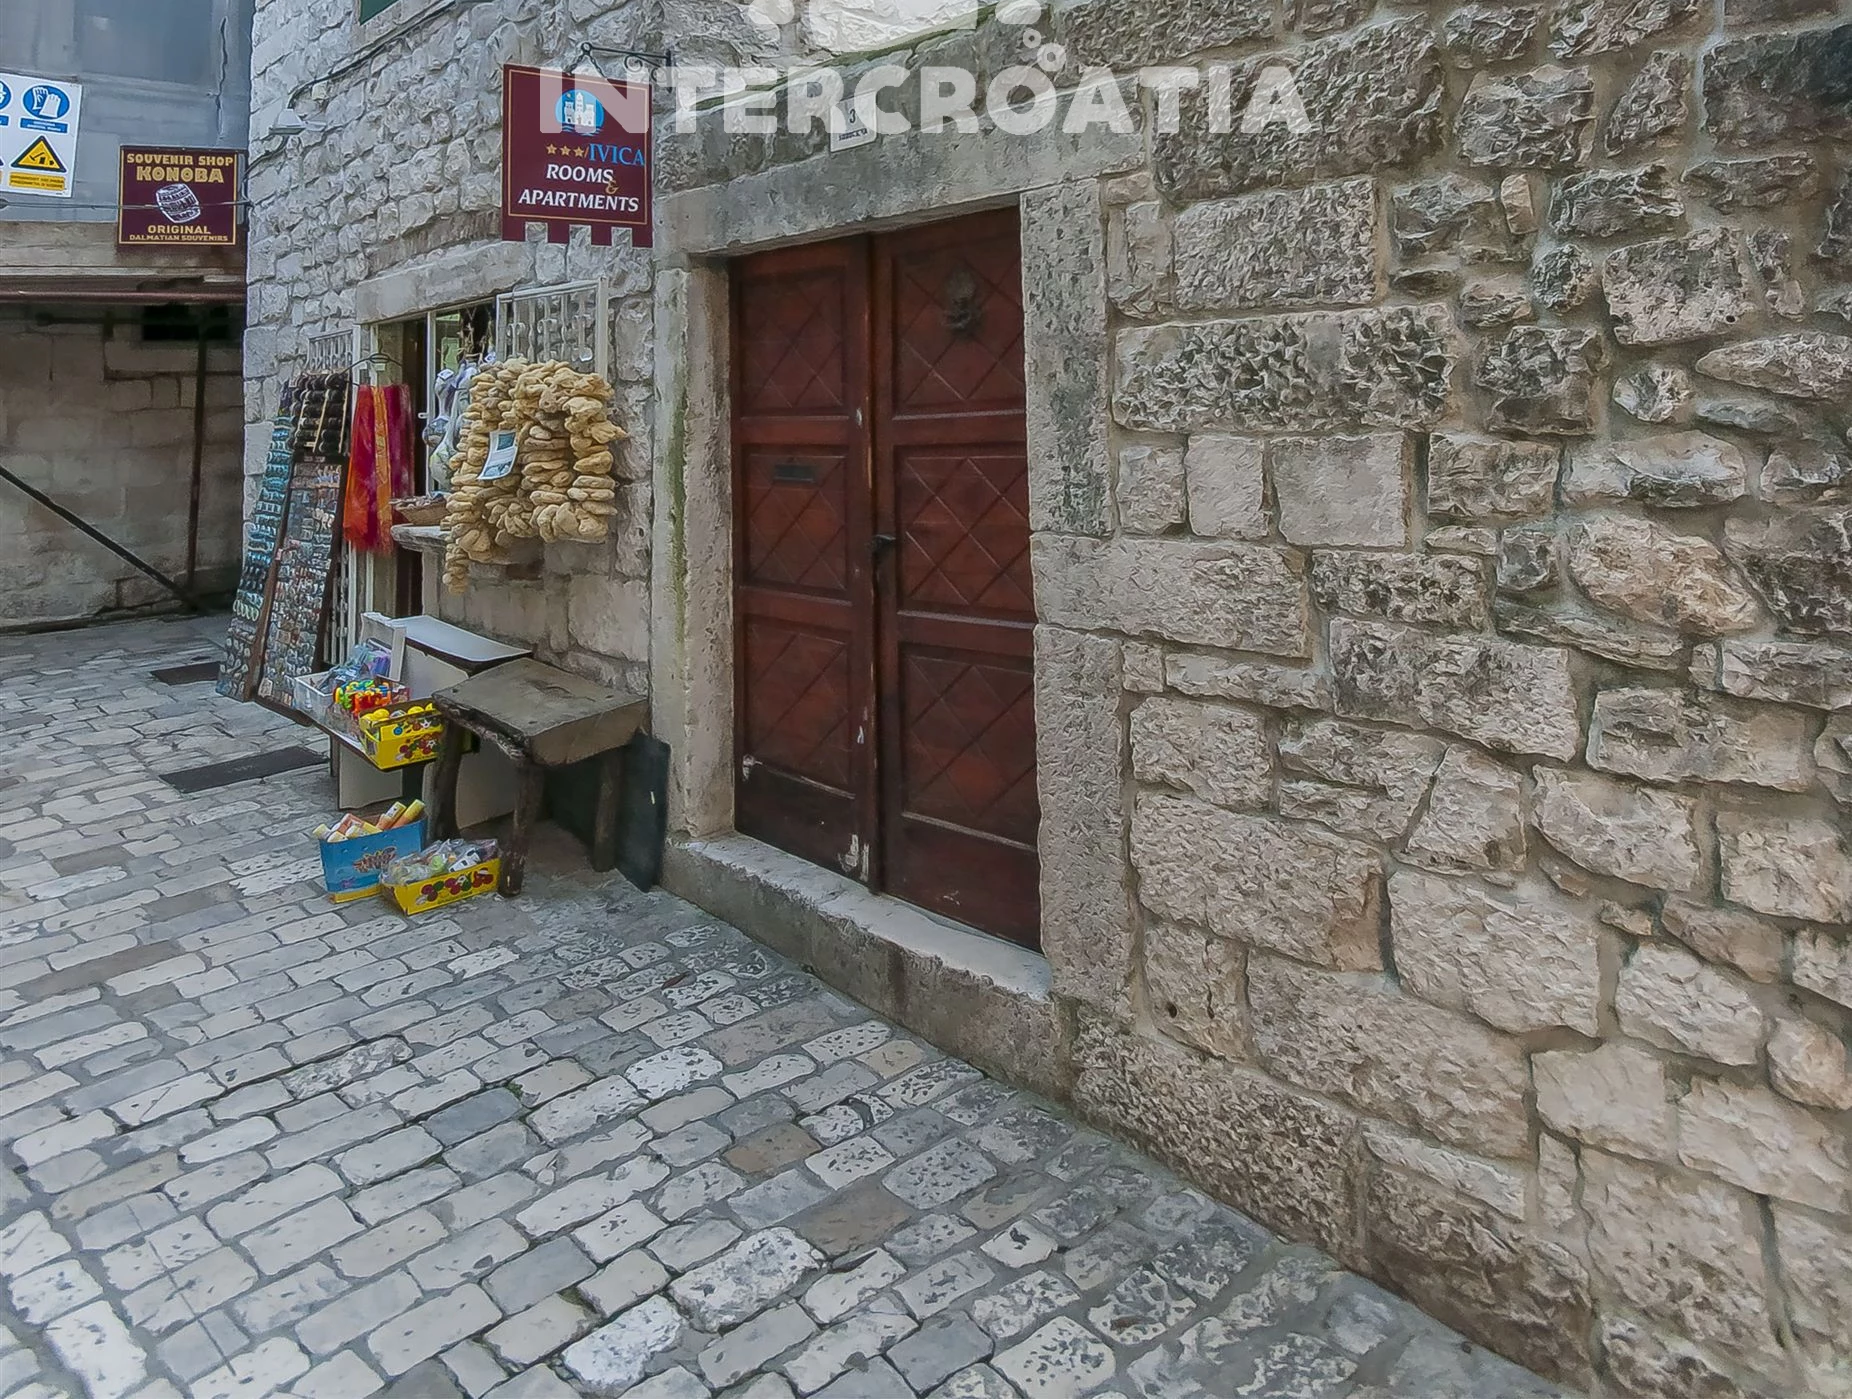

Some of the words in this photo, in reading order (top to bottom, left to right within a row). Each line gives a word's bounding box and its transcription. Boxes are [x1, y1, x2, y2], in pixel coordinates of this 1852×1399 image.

[126, 153, 194, 165] SOUVENIR
[198, 156, 234, 167] SHOP
[589, 143, 645, 165] IVICA
[136, 166, 225, 183] KONOBA
[546, 164, 614, 184] ROOMS
[605, 179, 620, 194] &
[518, 189, 639, 212] APARTMENTS
[147, 225, 212, 235] ORIGINAL
